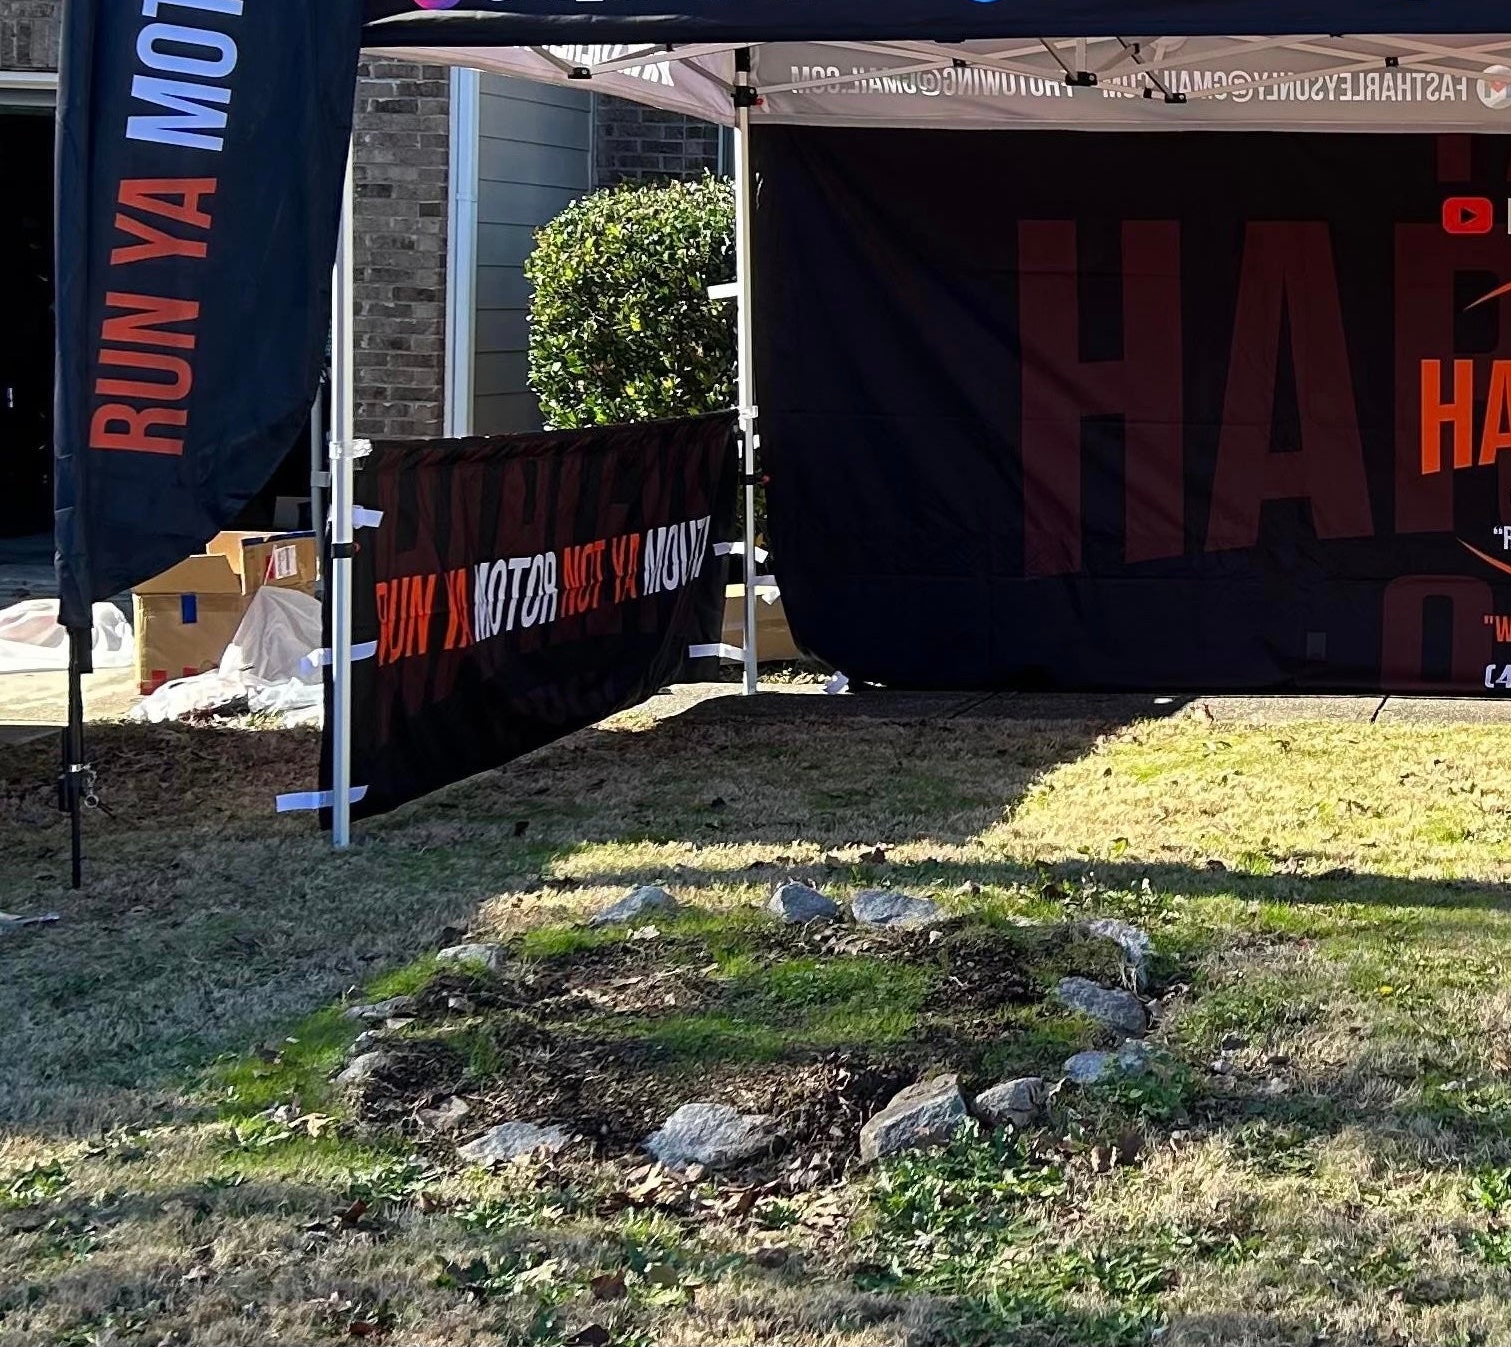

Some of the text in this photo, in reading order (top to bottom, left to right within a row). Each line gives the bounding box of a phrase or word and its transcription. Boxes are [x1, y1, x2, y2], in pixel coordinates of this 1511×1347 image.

[110, 177, 217, 265] YA
[89, 291, 200, 455] RUN
[375, 574, 437, 667] RUN
[474, 551, 558, 642] MOTOR
[561, 538, 605, 618] NOT
[611, 533, 641, 604] YA
